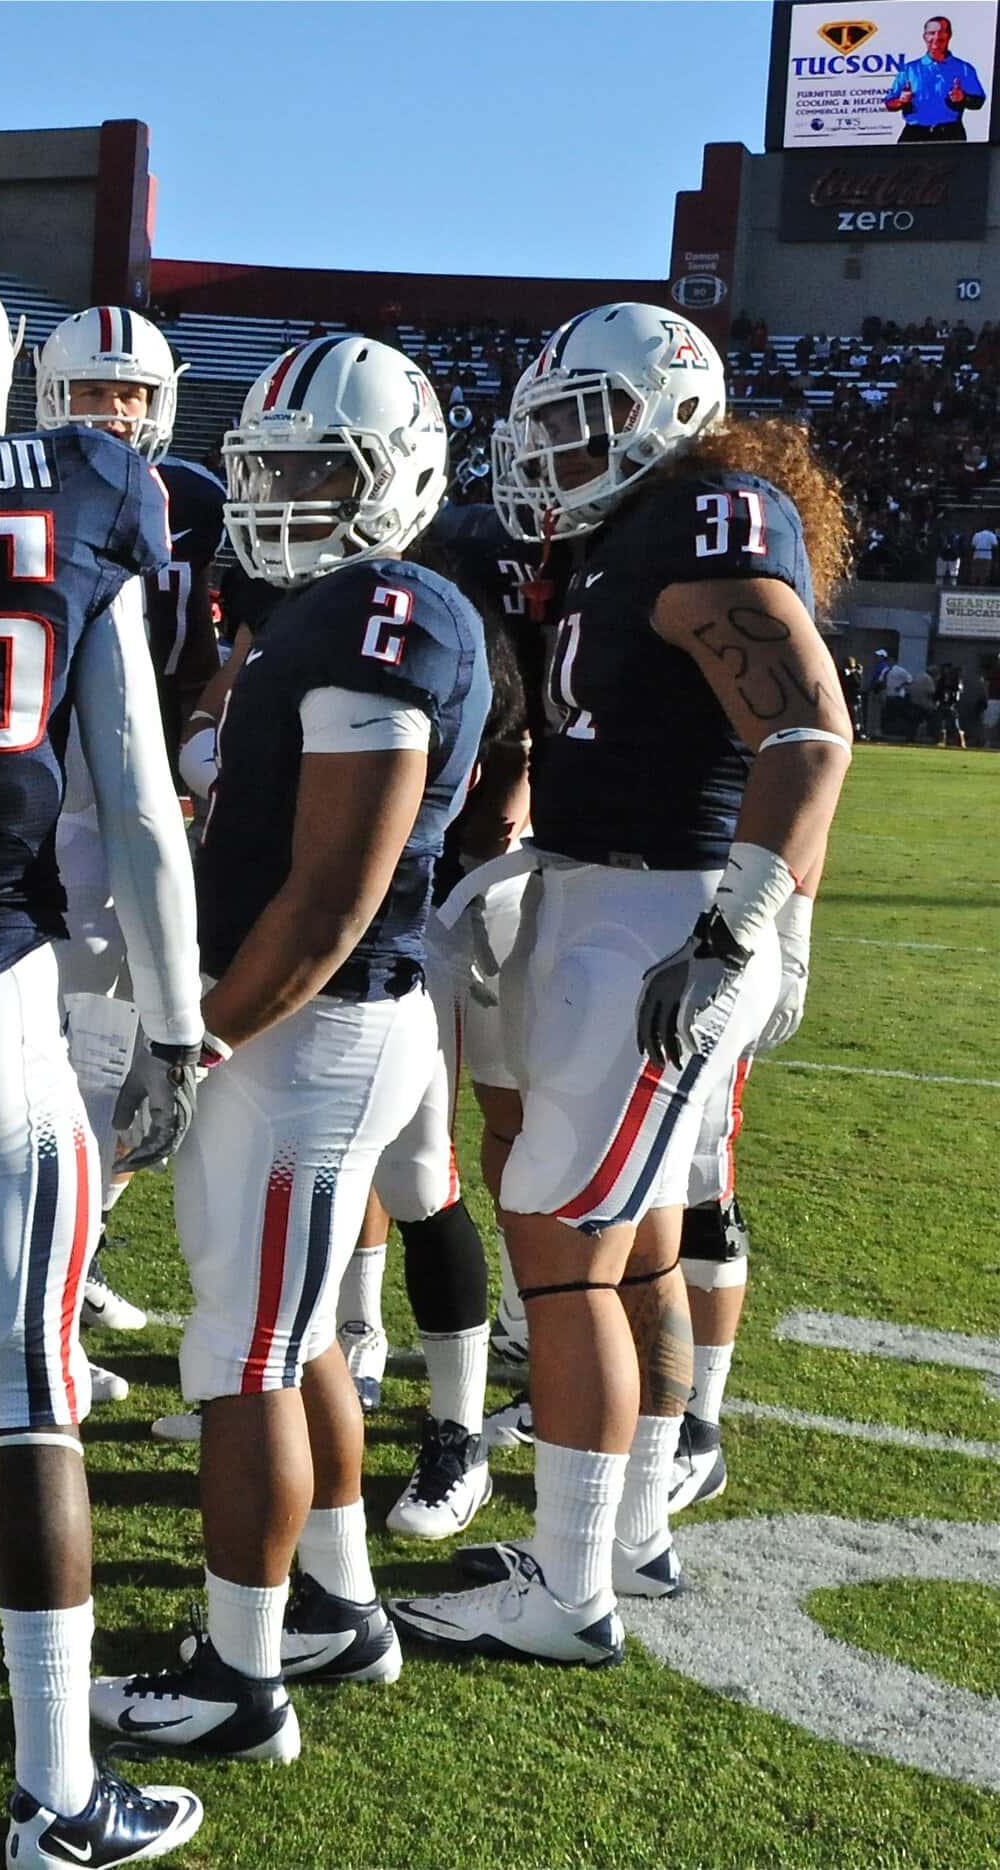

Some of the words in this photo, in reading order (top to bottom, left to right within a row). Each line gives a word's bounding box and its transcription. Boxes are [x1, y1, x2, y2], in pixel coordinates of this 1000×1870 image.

[791, 53, 905, 76] TUCSON
[795, 98, 840, 107] COOLING
[842, 98, 850, 106] &
[796, 89, 847, 99] FURNITURE
[795, 107, 849, 116] COMMERCIAL
[837, 210, 914, 231] zero
[957, 281, 981, 299] 10
[660, 321, 709, 370] A
[694, 488, 768, 558] 31
[946, 608, 1000, 617] WILDCAT
[360, 585, 414, 667] 2
[693, 606, 792, 680] 50
